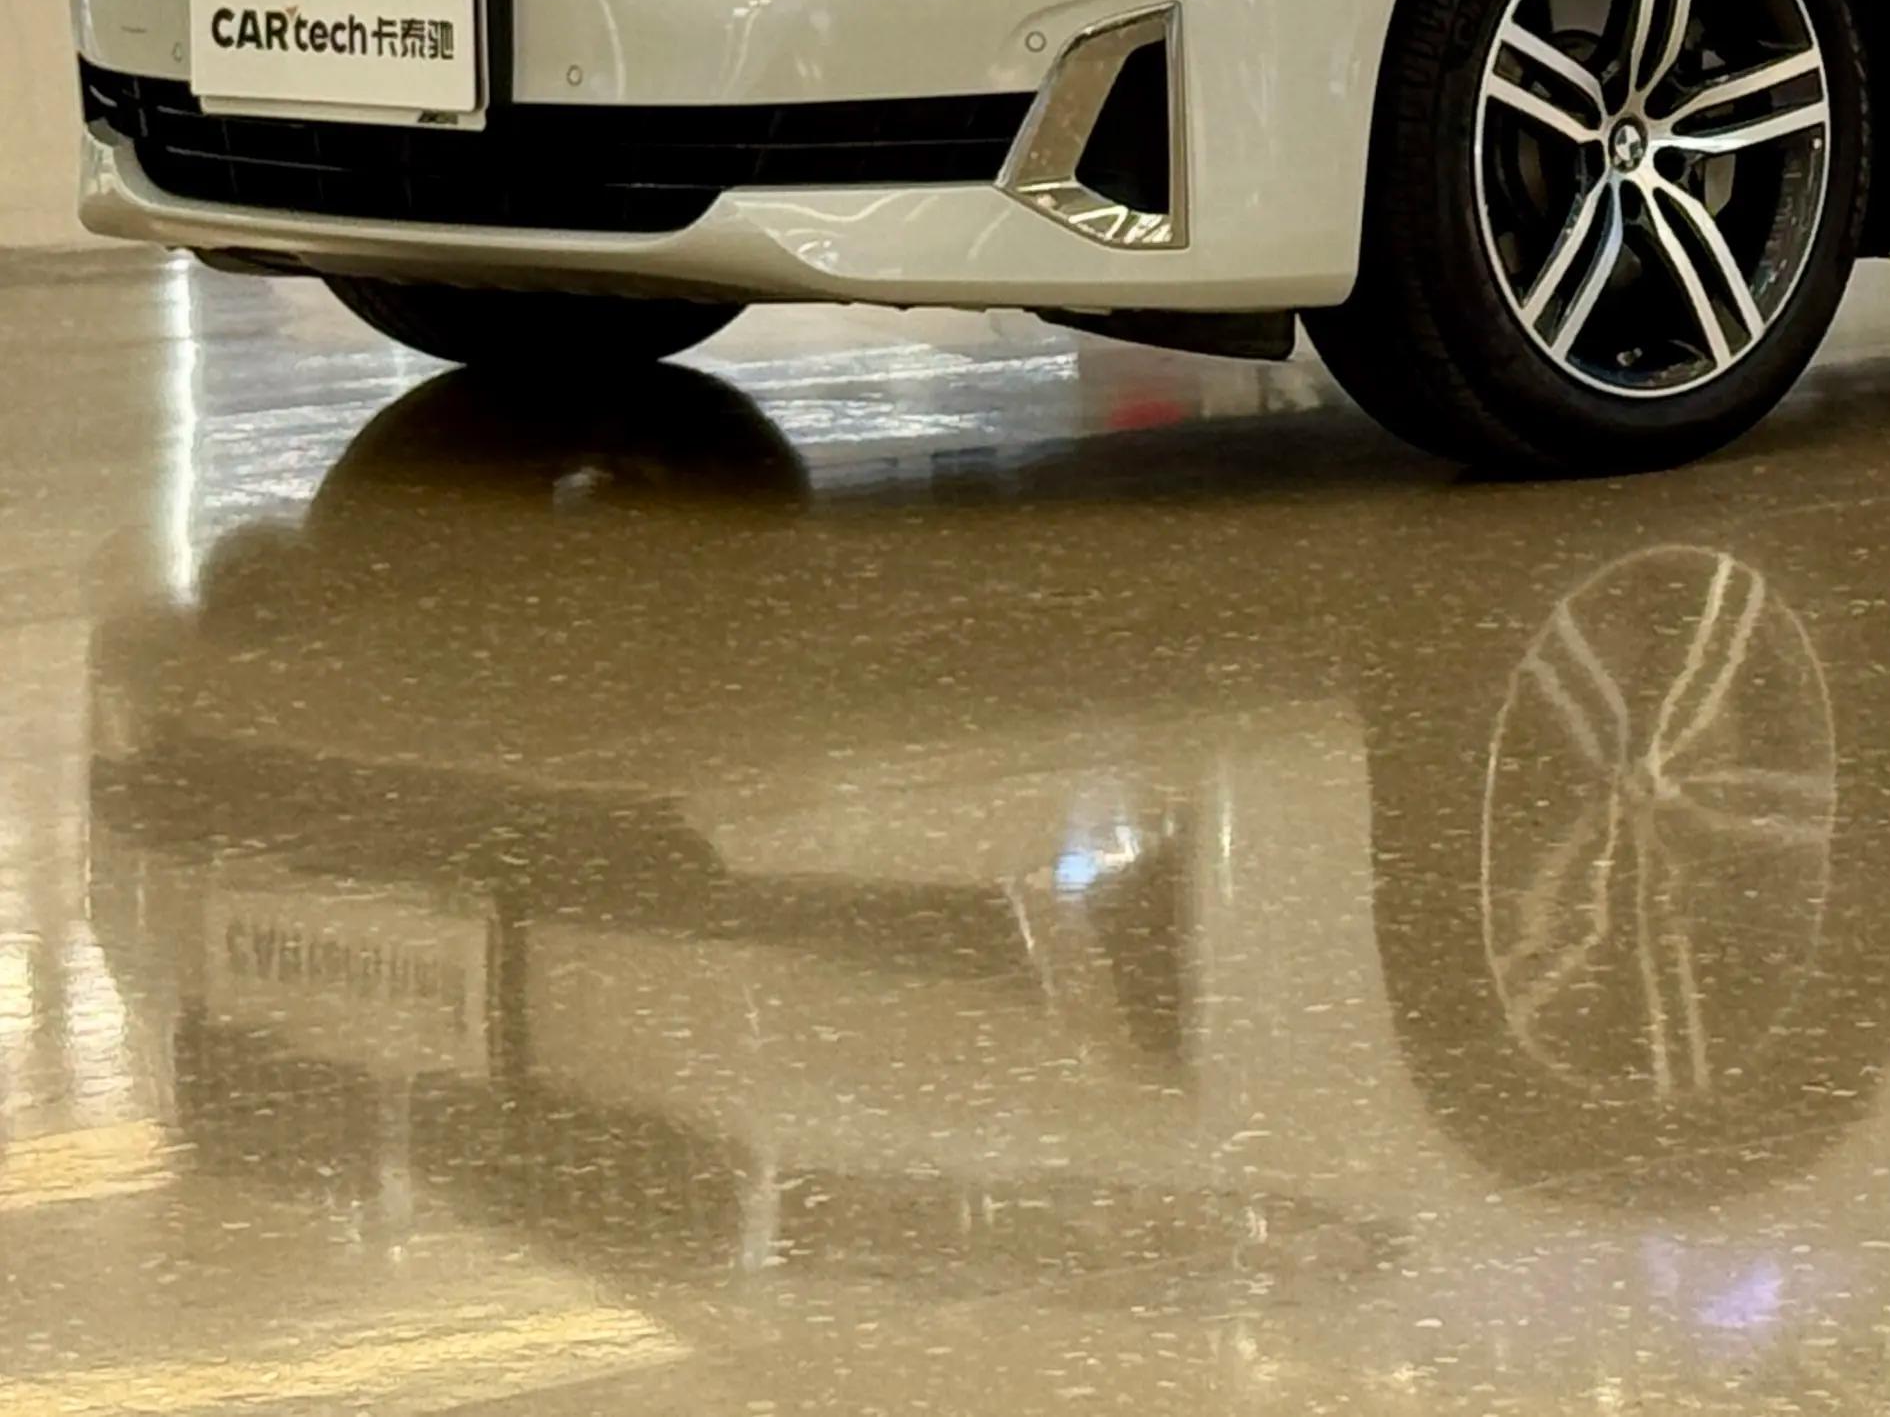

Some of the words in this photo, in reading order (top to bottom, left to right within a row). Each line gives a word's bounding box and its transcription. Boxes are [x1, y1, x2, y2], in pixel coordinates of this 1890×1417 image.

[211, 5, 367, 55] CARtech
[371, 16, 455, 61] 卡泰驰
